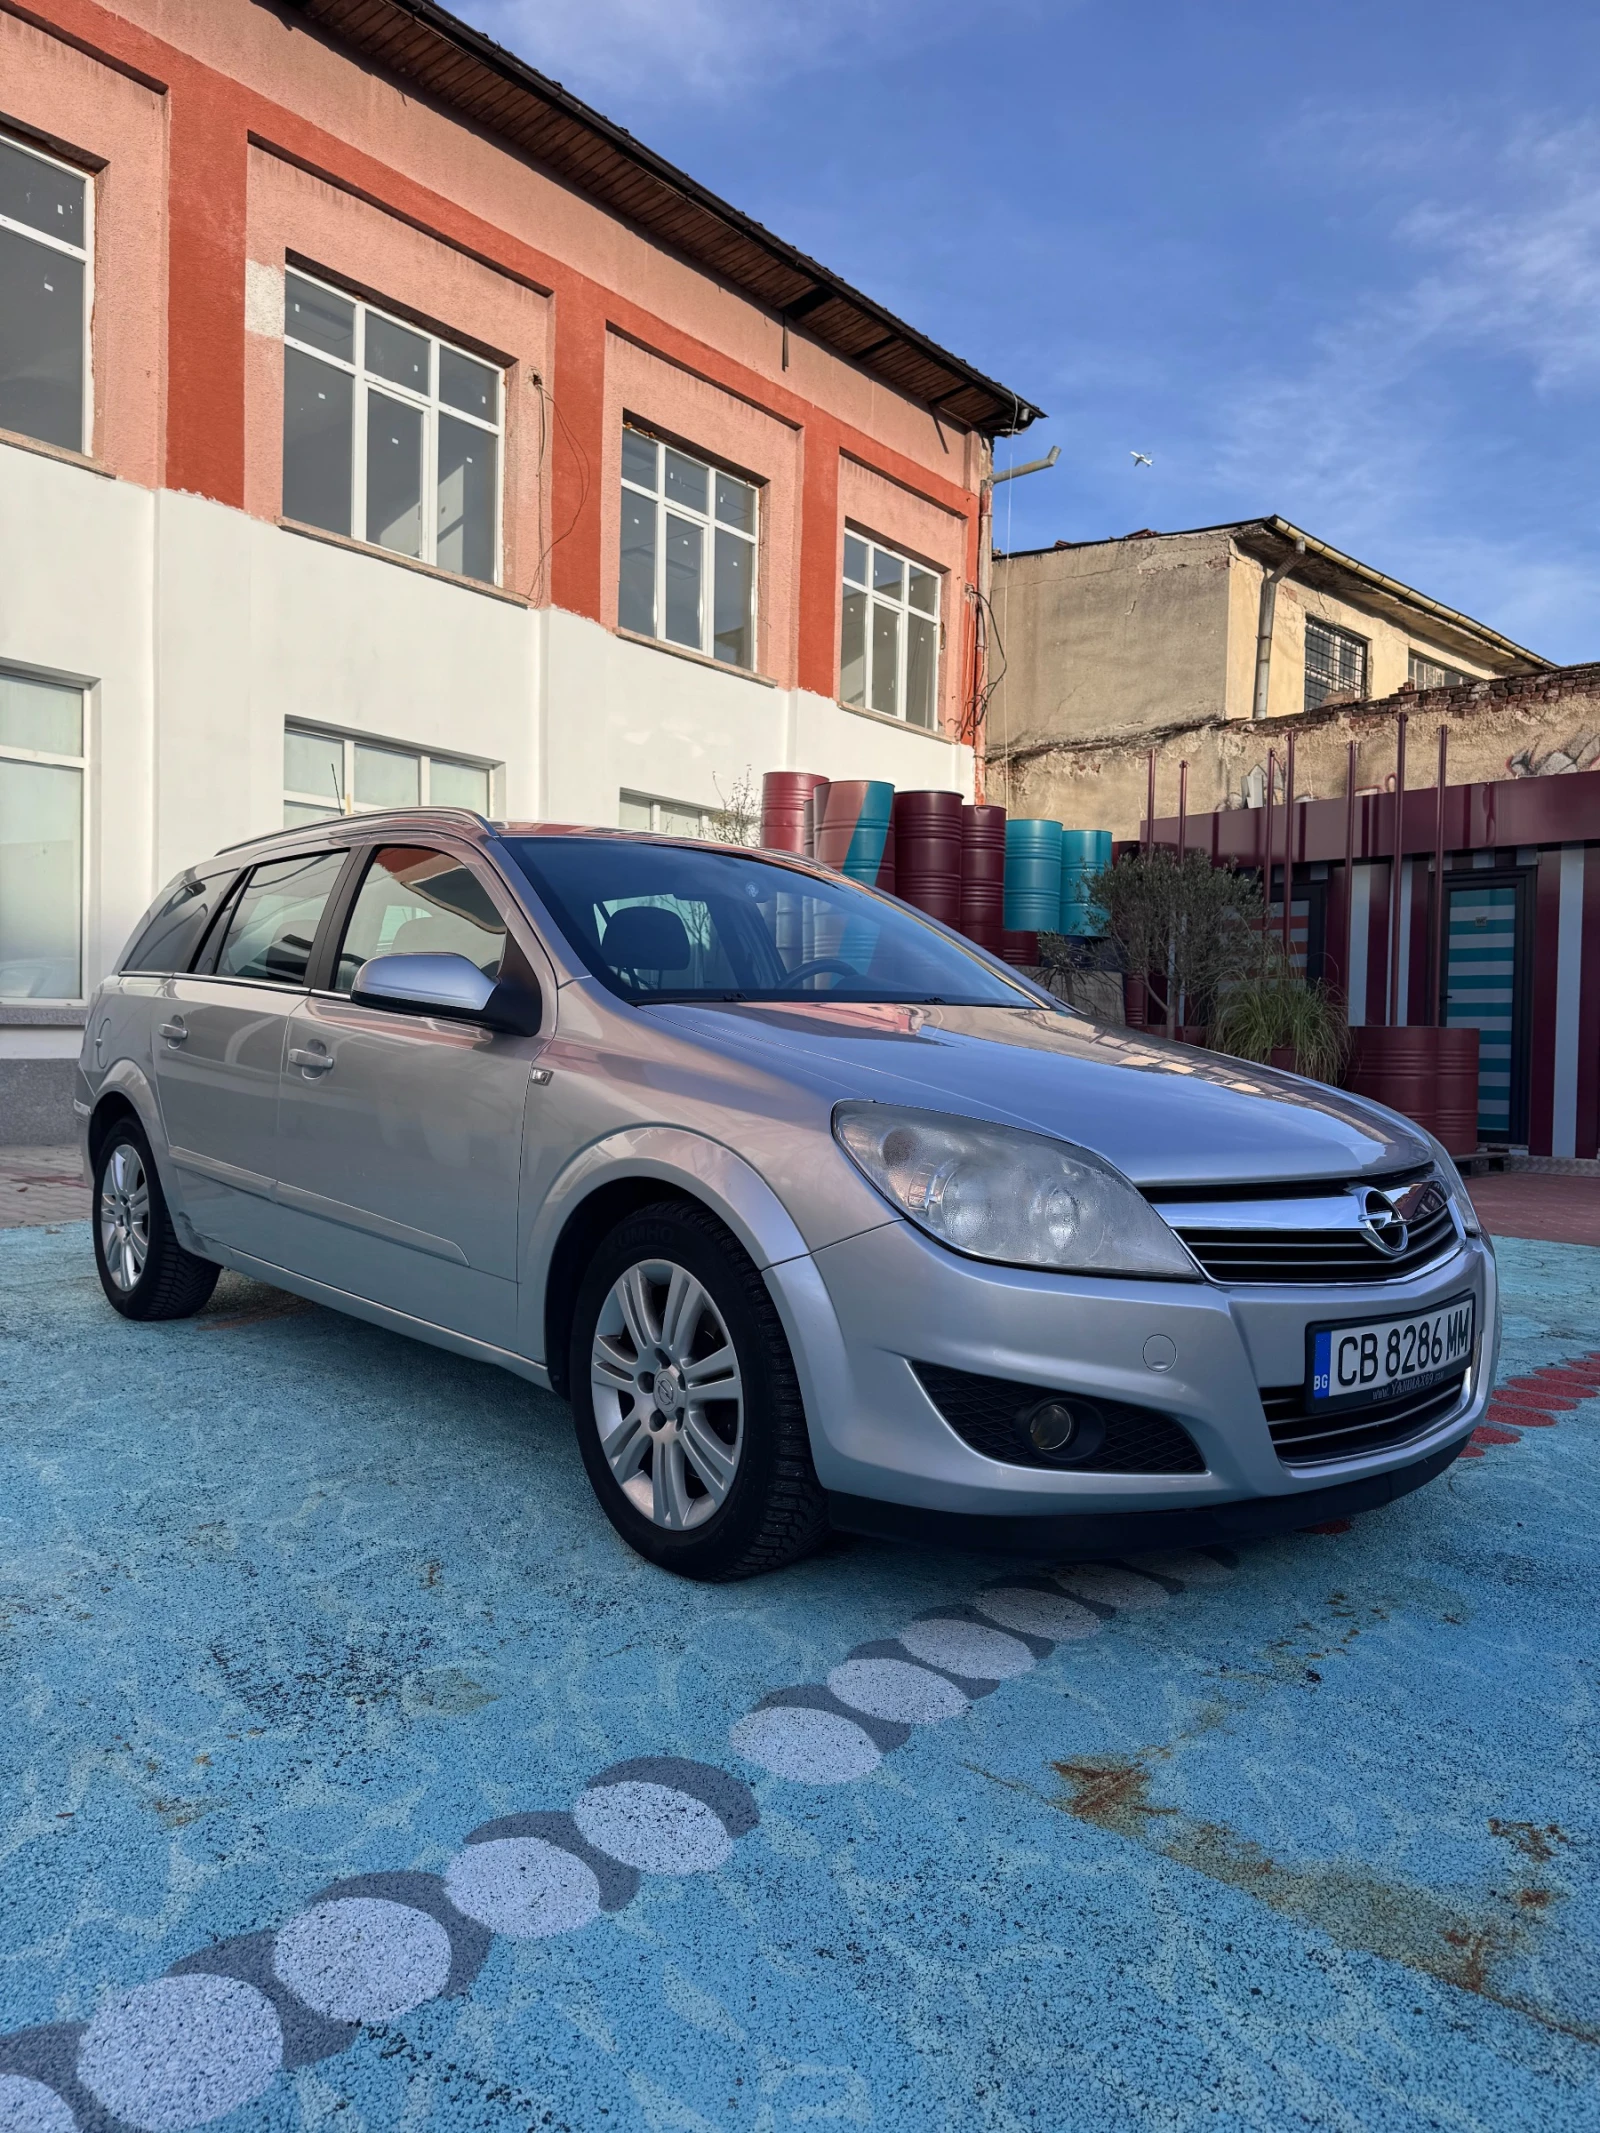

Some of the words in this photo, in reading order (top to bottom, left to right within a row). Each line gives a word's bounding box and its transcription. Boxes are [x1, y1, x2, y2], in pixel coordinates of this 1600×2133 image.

[1338, 1333, 1378, 1386] CB
[1385, 1317, 1442, 1377] 8286
[1446, 1307, 1470, 1361] MM
[1314, 1375, 1328, 1390] BG
